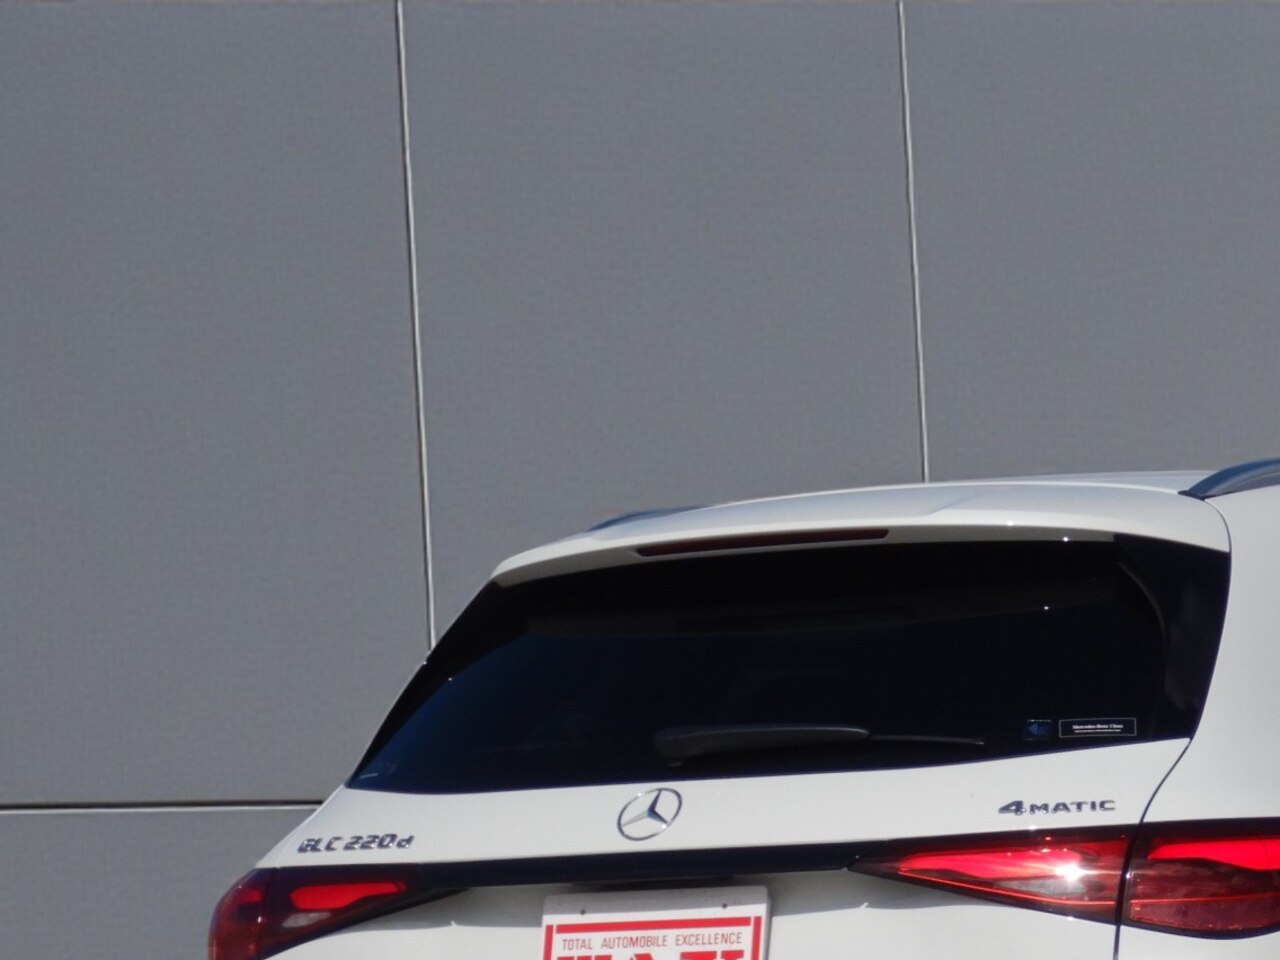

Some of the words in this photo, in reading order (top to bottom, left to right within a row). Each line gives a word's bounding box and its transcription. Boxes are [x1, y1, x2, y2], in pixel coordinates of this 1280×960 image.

[998, 800, 1116, 815] 4MATIC
[297, 836, 343, 853] GLC
[342, 833, 415, 851] 220d
[562, 938, 593, 950] TOTAL
[601, 935, 669, 949] AUTOMOBILE
[675, 932, 743, 946] EXCELLENCE
